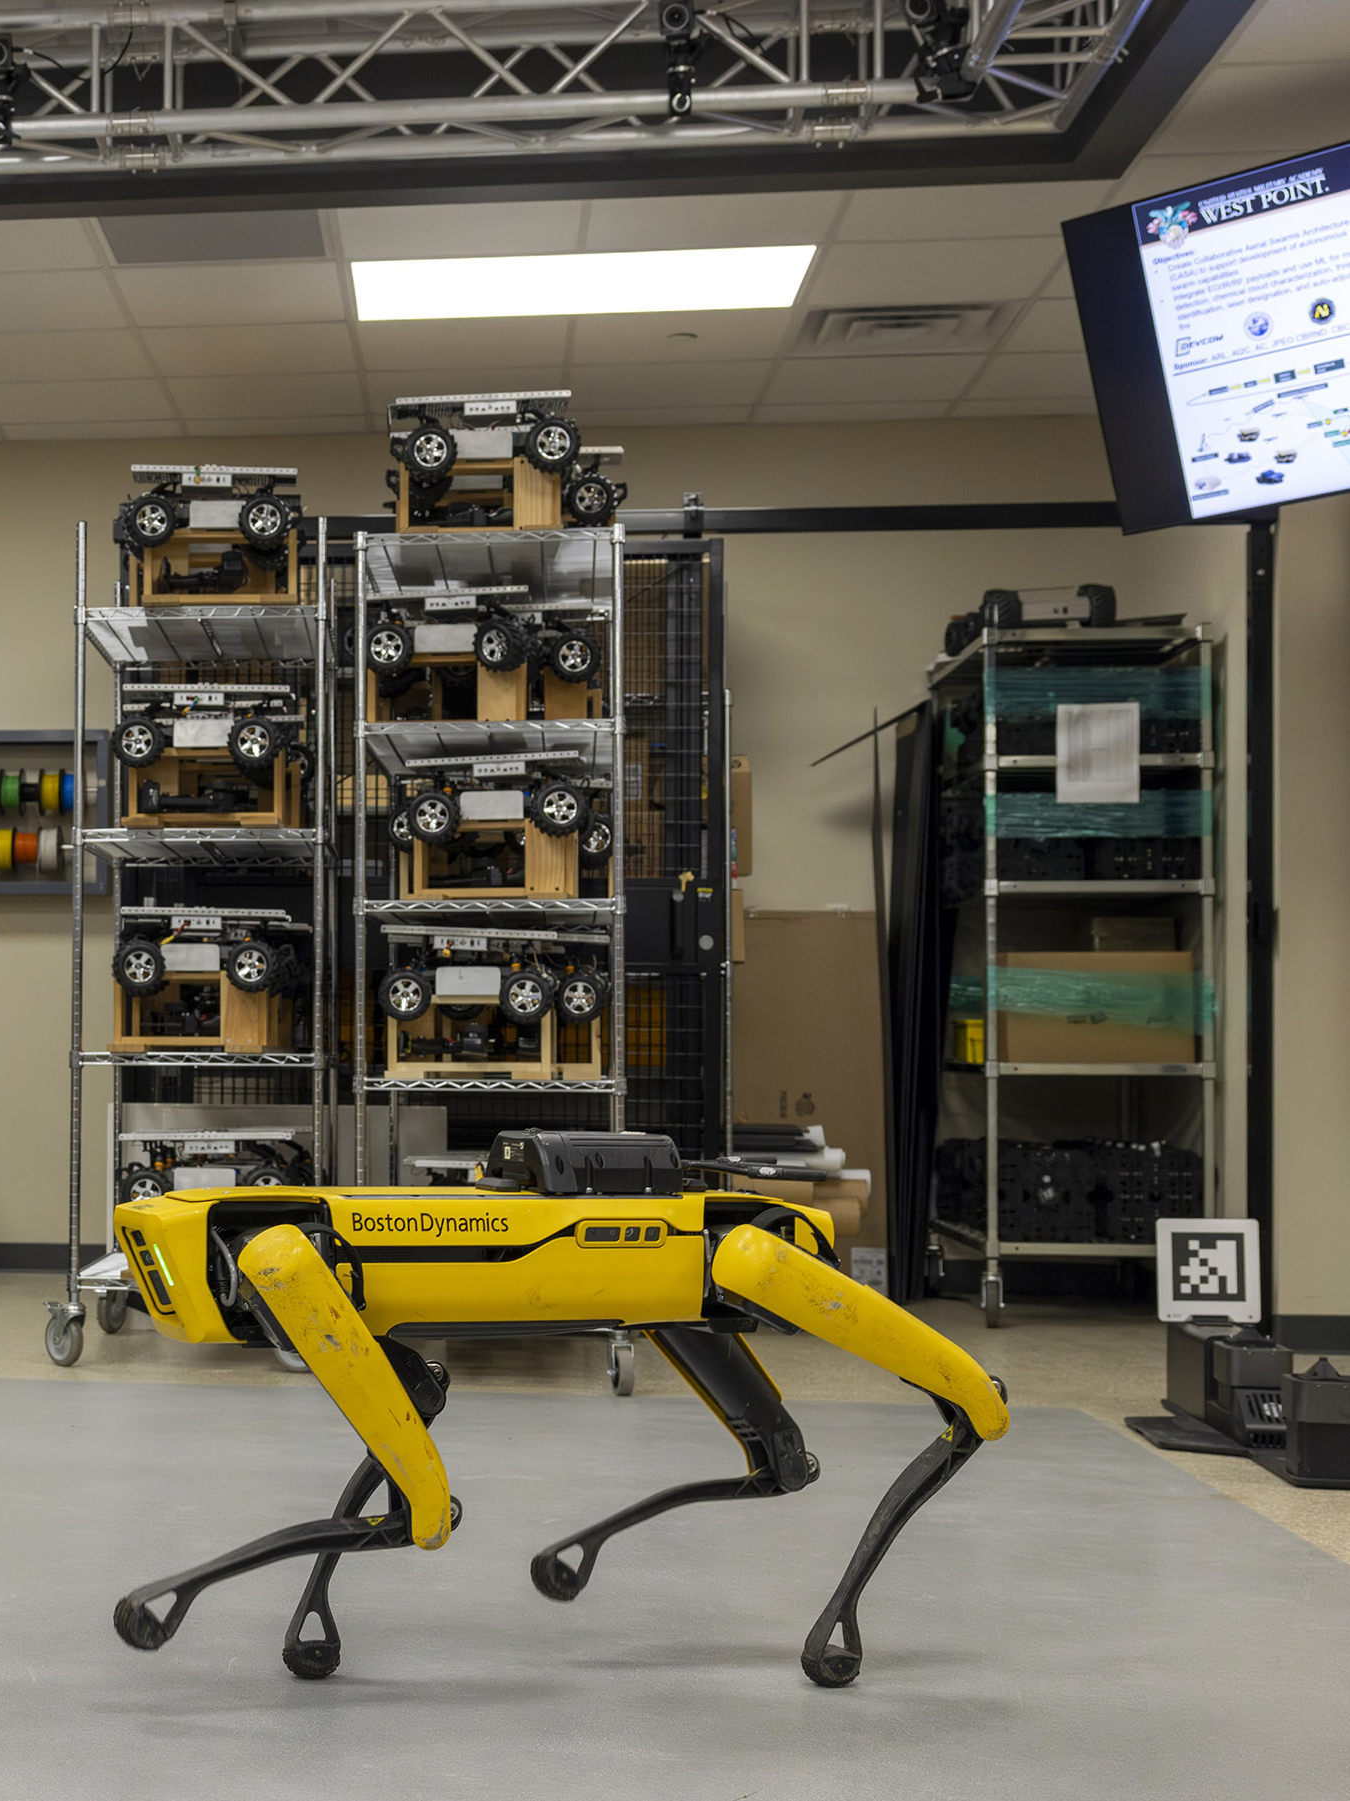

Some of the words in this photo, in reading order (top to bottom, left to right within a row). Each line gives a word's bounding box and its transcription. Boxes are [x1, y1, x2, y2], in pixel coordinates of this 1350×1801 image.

[1199, 197, 1256, 224] WEST
[1301, 219, 1349, 236] Architecture
[351, 1212, 418, 1232] Boston
[420, 1213, 509, 1237] Dynamics
